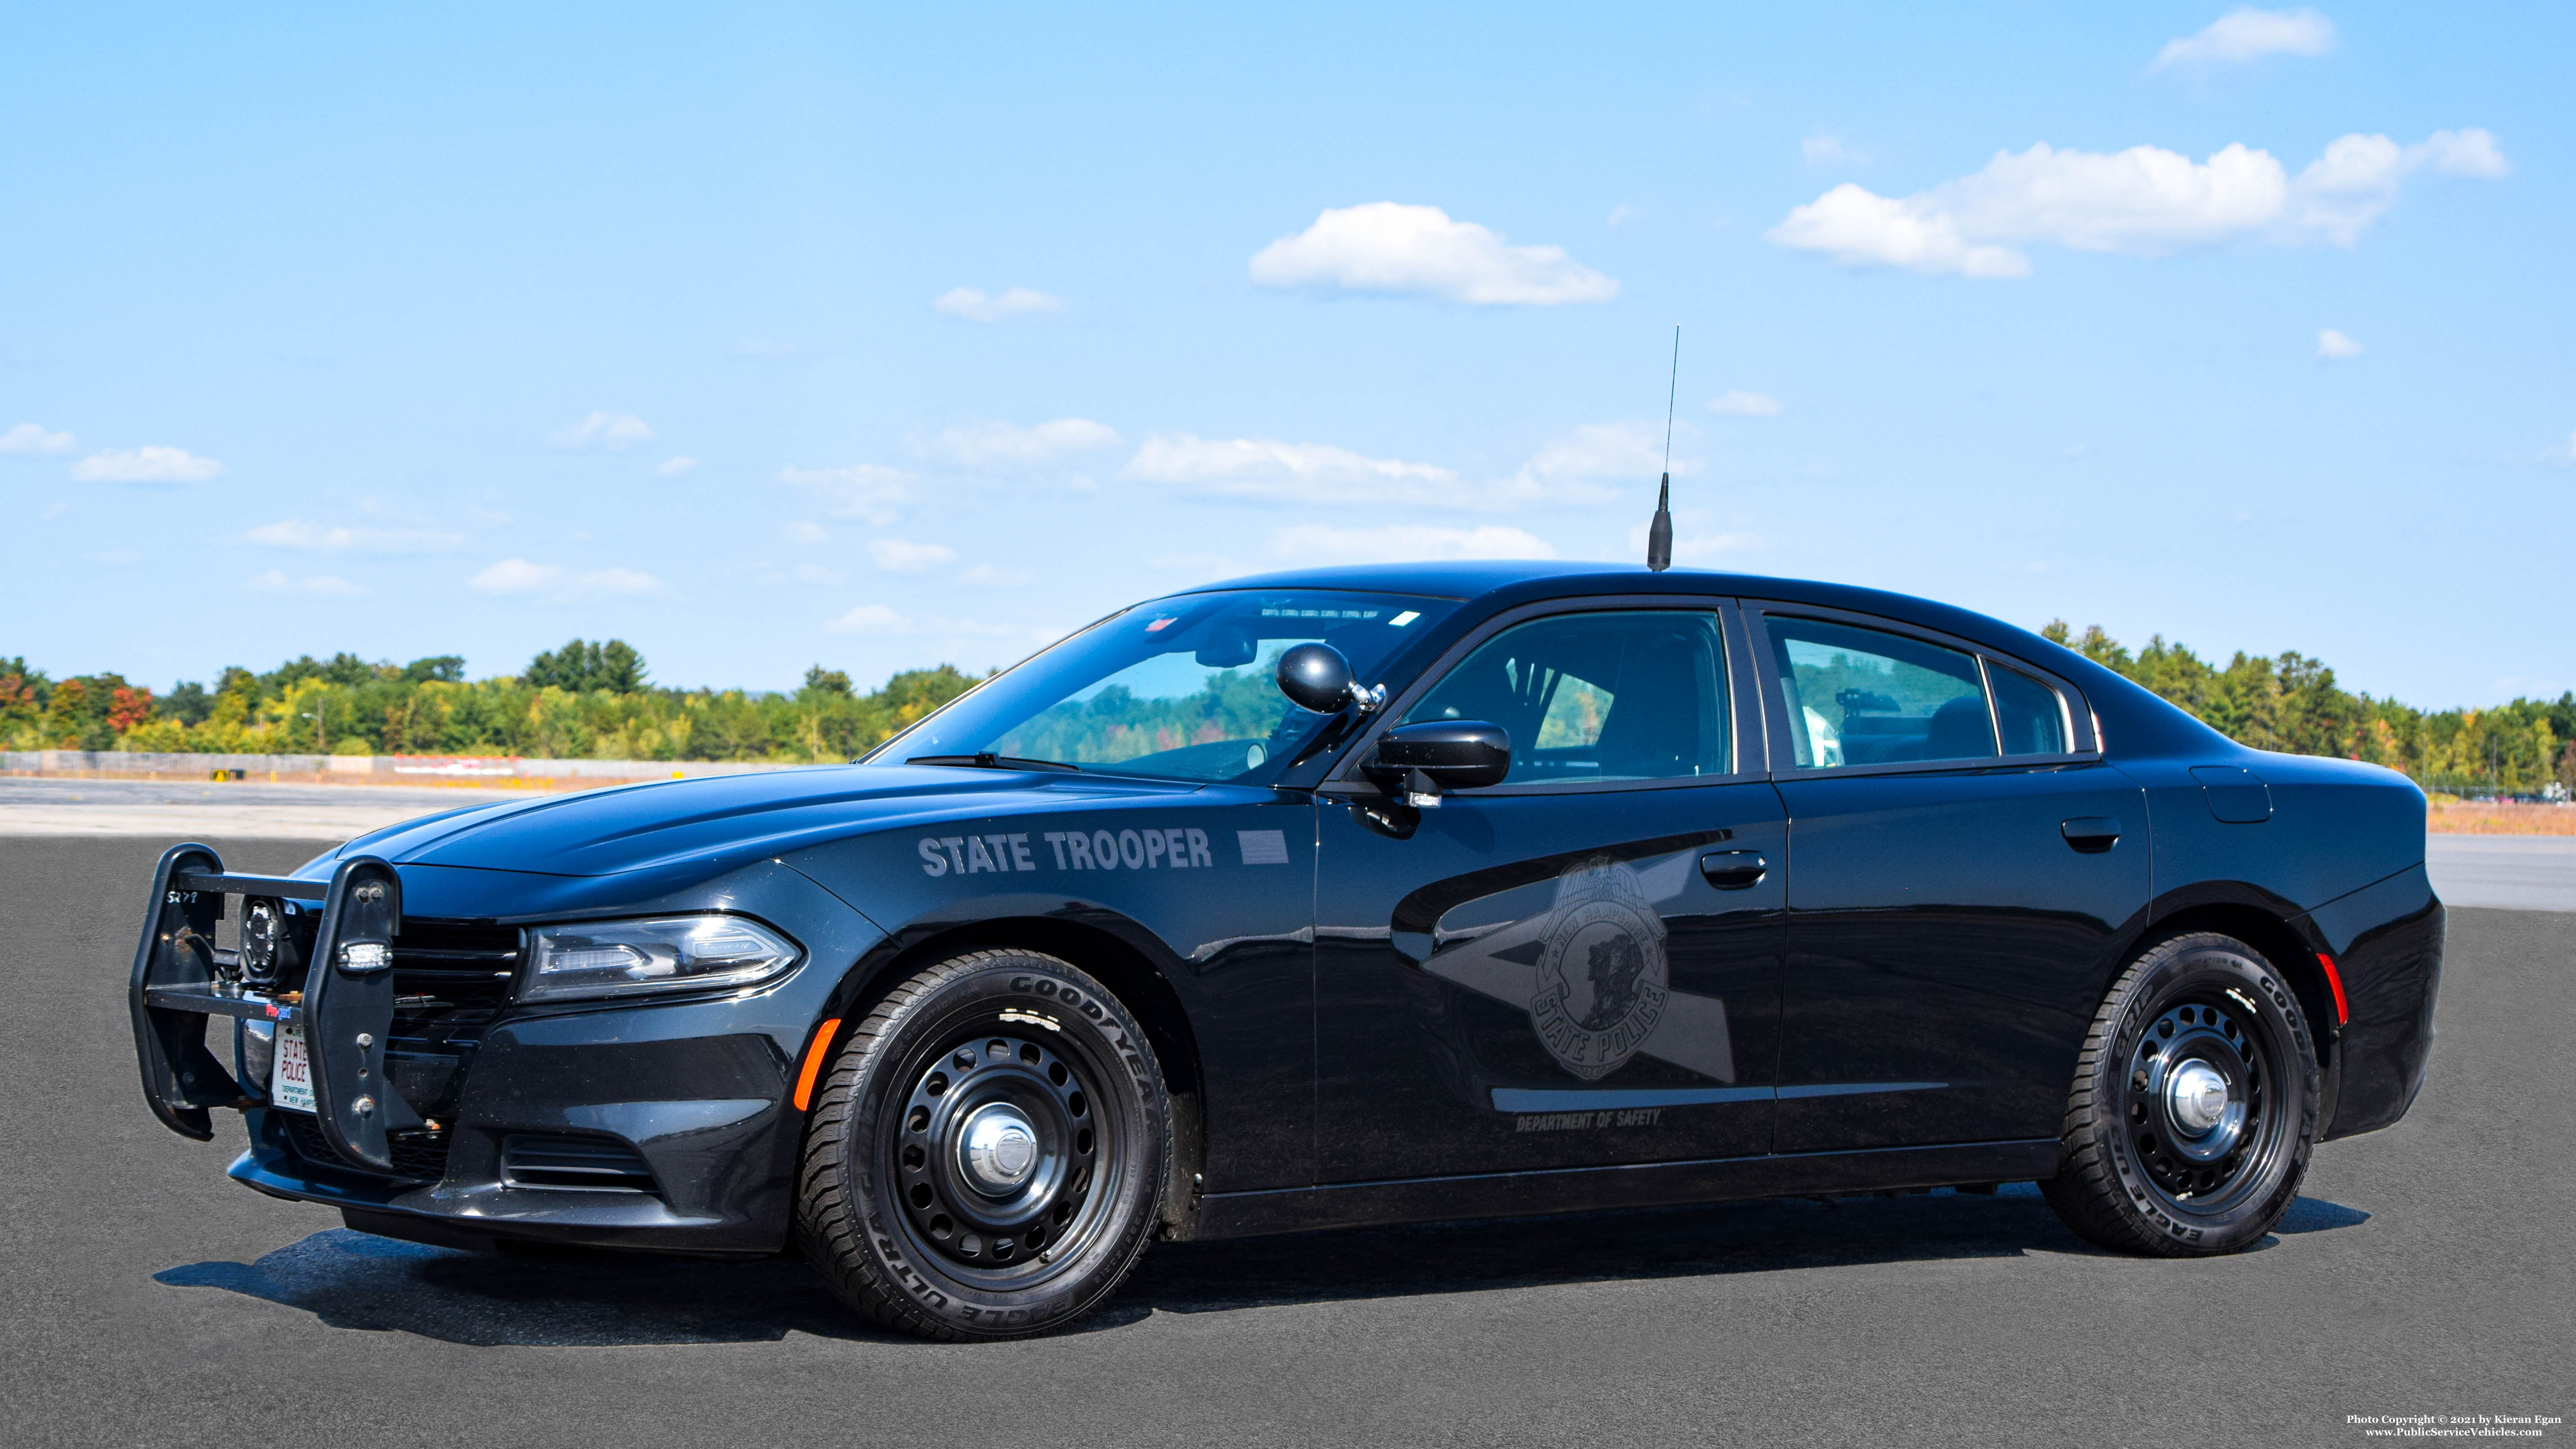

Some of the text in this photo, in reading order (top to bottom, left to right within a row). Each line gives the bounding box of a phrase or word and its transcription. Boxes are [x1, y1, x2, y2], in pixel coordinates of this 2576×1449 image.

[918, 828, 1213, 877] STATE TROOPER
[1554, 906, 1649, 947] NEW HAMPSHIRE
[1535, 986, 1665, 1062] STATE POLICE
[2116, 983, 2153, 1058] GRIP
[281, 1060, 306, 1082] POLICE
[284, 1040, 307, 1061] STATE
[1010, 976, 1156, 1135] GOODYEAR
[282, 1085, 308, 1095] DEPARTMENT
[300, 1098, 316, 1107] HAMPS
[1516, 1108, 1661, 1133] DEPARTMENT OF SAFETY
[2130, 1184, 2203, 1242] EAGLE
[867, 1210, 948, 1310] ULTRA
[955, 1292, 1073, 1324] EAGLE
